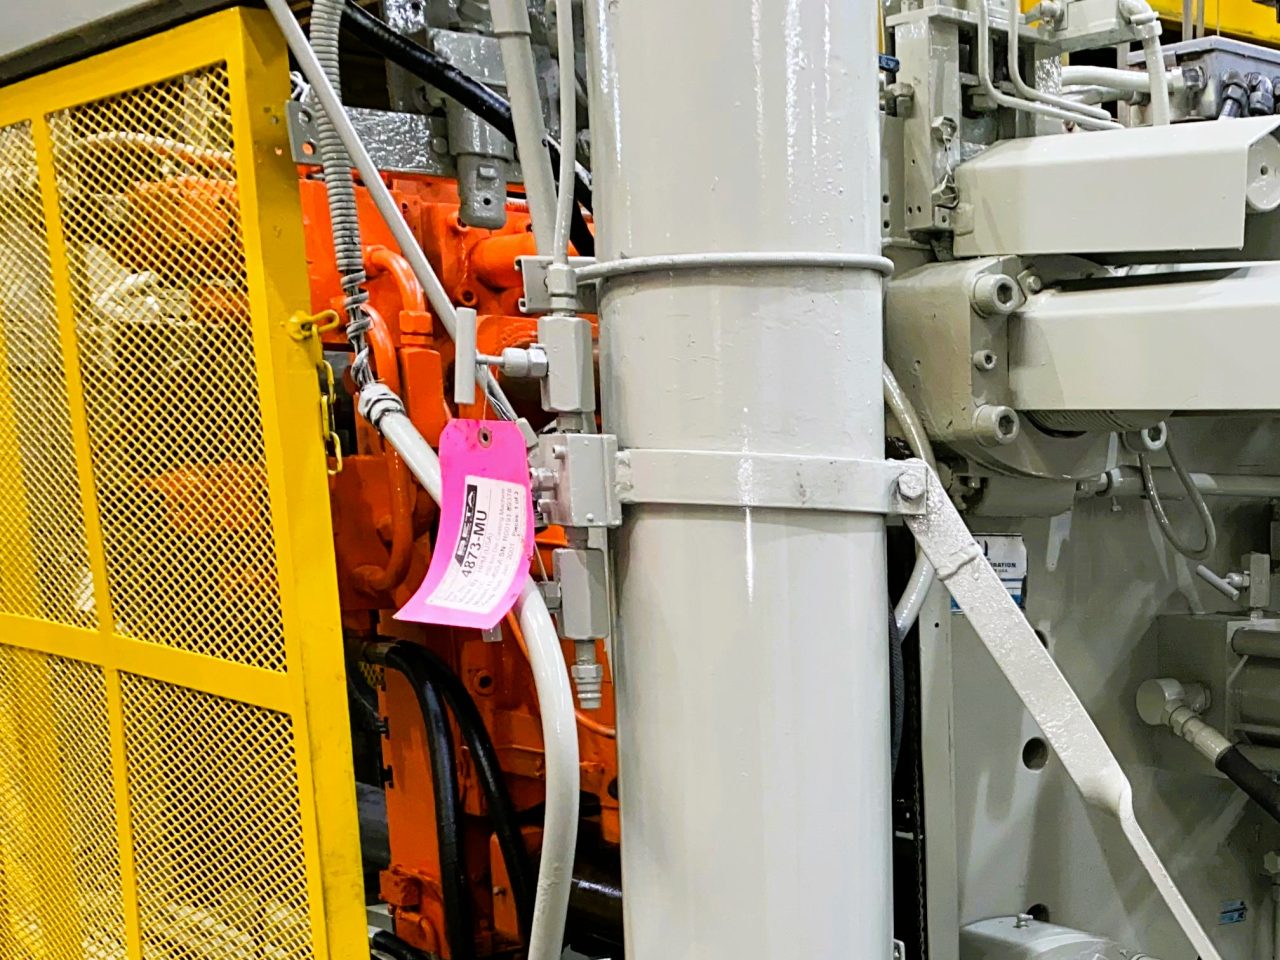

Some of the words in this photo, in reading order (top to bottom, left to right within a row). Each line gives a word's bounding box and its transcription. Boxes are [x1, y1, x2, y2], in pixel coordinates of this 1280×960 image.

[498, 487, 507, 516] Machine
[462, 510, 488, 578] 4873-MU
[482, 531, 493, 554] (USA)
